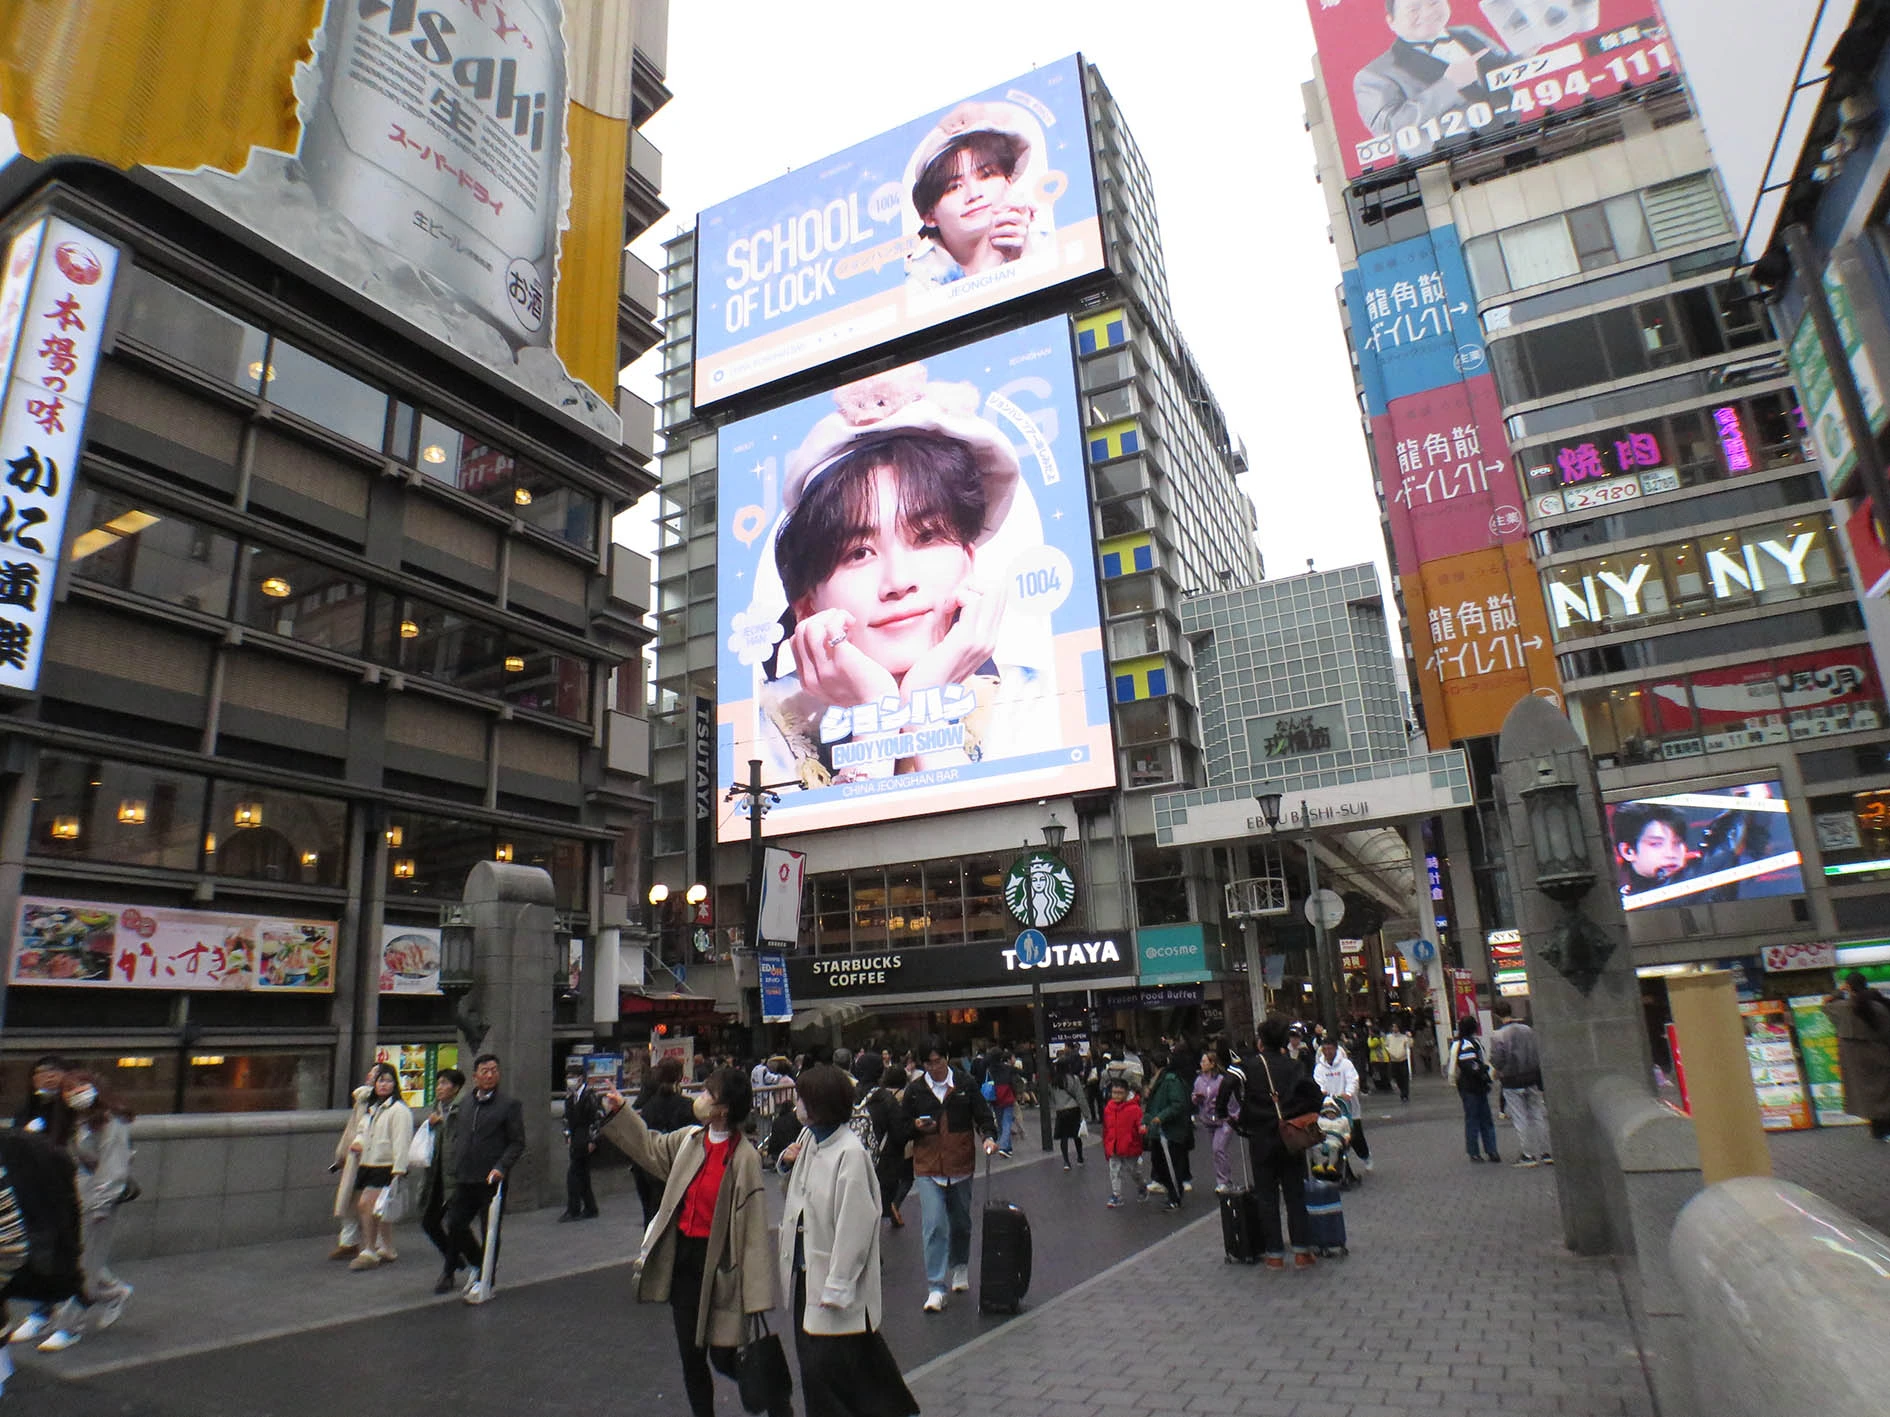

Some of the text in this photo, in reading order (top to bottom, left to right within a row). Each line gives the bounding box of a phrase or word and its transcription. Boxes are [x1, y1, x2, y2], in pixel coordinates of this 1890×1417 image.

[1493, 56, 1551, 86] ルアン
[430, 87, 477, 147] 生
[1396, 43, 1674, 152] 0120-494-111
[388, 122, 504, 216] スーパードライ
[726, 191, 874, 290] SCHOOL
[508, 270, 544, 323] お酒
[726, 257, 837, 333] OF LOCK
[948, 266, 1016, 299] JEONGHAN
[1364, 270, 1448, 322] 龍角散
[1363, 300, 1470, 352] ダイレクト
[26, 292, 87, 435] 本場の味
[1396, 423, 1485, 475] 龍角散
[1530, 467, 1552, 477] OPEN
[1557, 432, 1663, 484] 焼肉
[1394, 459, 1505, 509] ダイレクト
[1015, 566, 1062, 598] 1004
[1549, 530, 1816, 629] NY NY
[1427, 592, 1521, 644] 龍角散
[1424, 633, 1543, 683] ダイレクト
[819, 681, 977, 744] ジョンハン
[696, 709, 710, 820] TSUTAYA
[833, 725, 964, 767] ENJOY YOUR SHOW
[842, 768, 960, 798] CHINA JEONGHAN BAR
[117, 941, 227, 983] かにすき
[812, 954, 902, 974] STARBUCKS
[1145, 943, 1199, 960] @cosme
[828, 971, 886, 987] COFFEE
[1167, 989, 1198, 1000] Buffet
